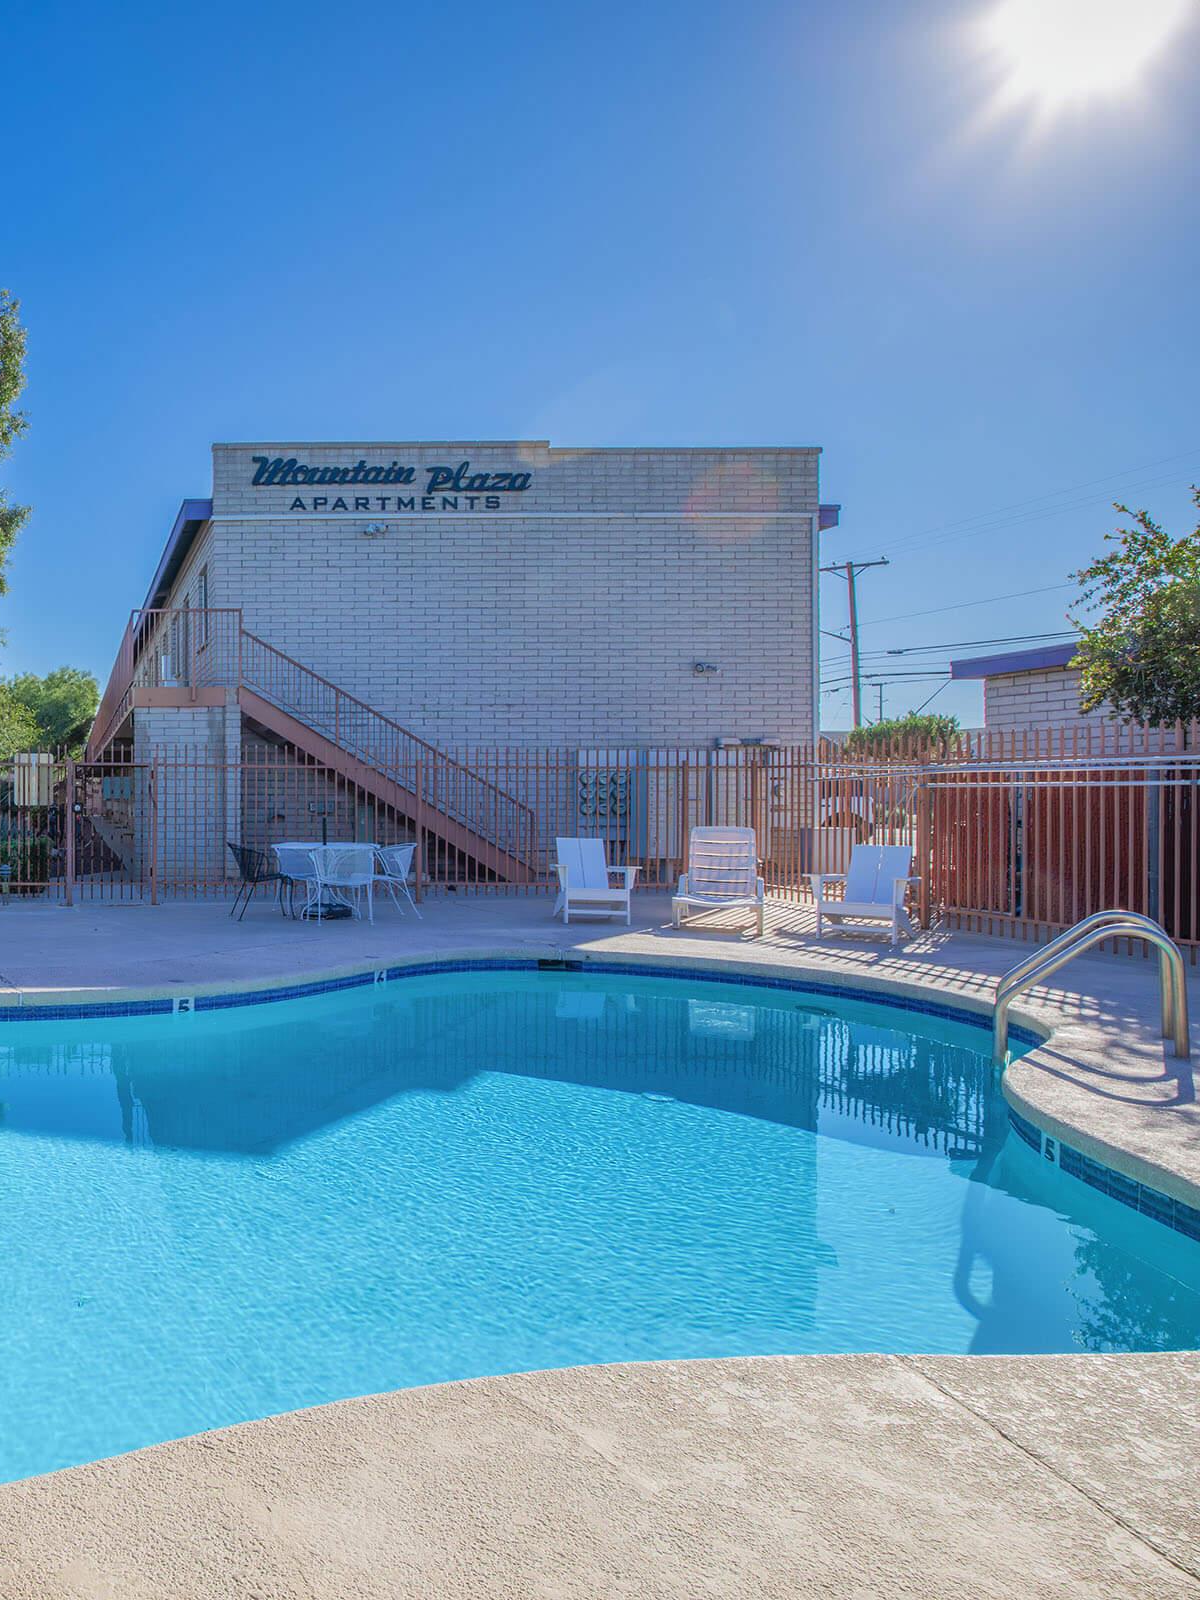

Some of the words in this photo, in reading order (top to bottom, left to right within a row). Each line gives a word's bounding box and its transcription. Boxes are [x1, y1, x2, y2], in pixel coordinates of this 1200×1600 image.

[252, 456, 417, 486] Mountain
[426, 461, 532, 494] Plaza
[289, 496, 501, 511] APARTMENTS
[178, 999, 189, 1012] 5
[1044, 1137, 1055, 1162] 5
